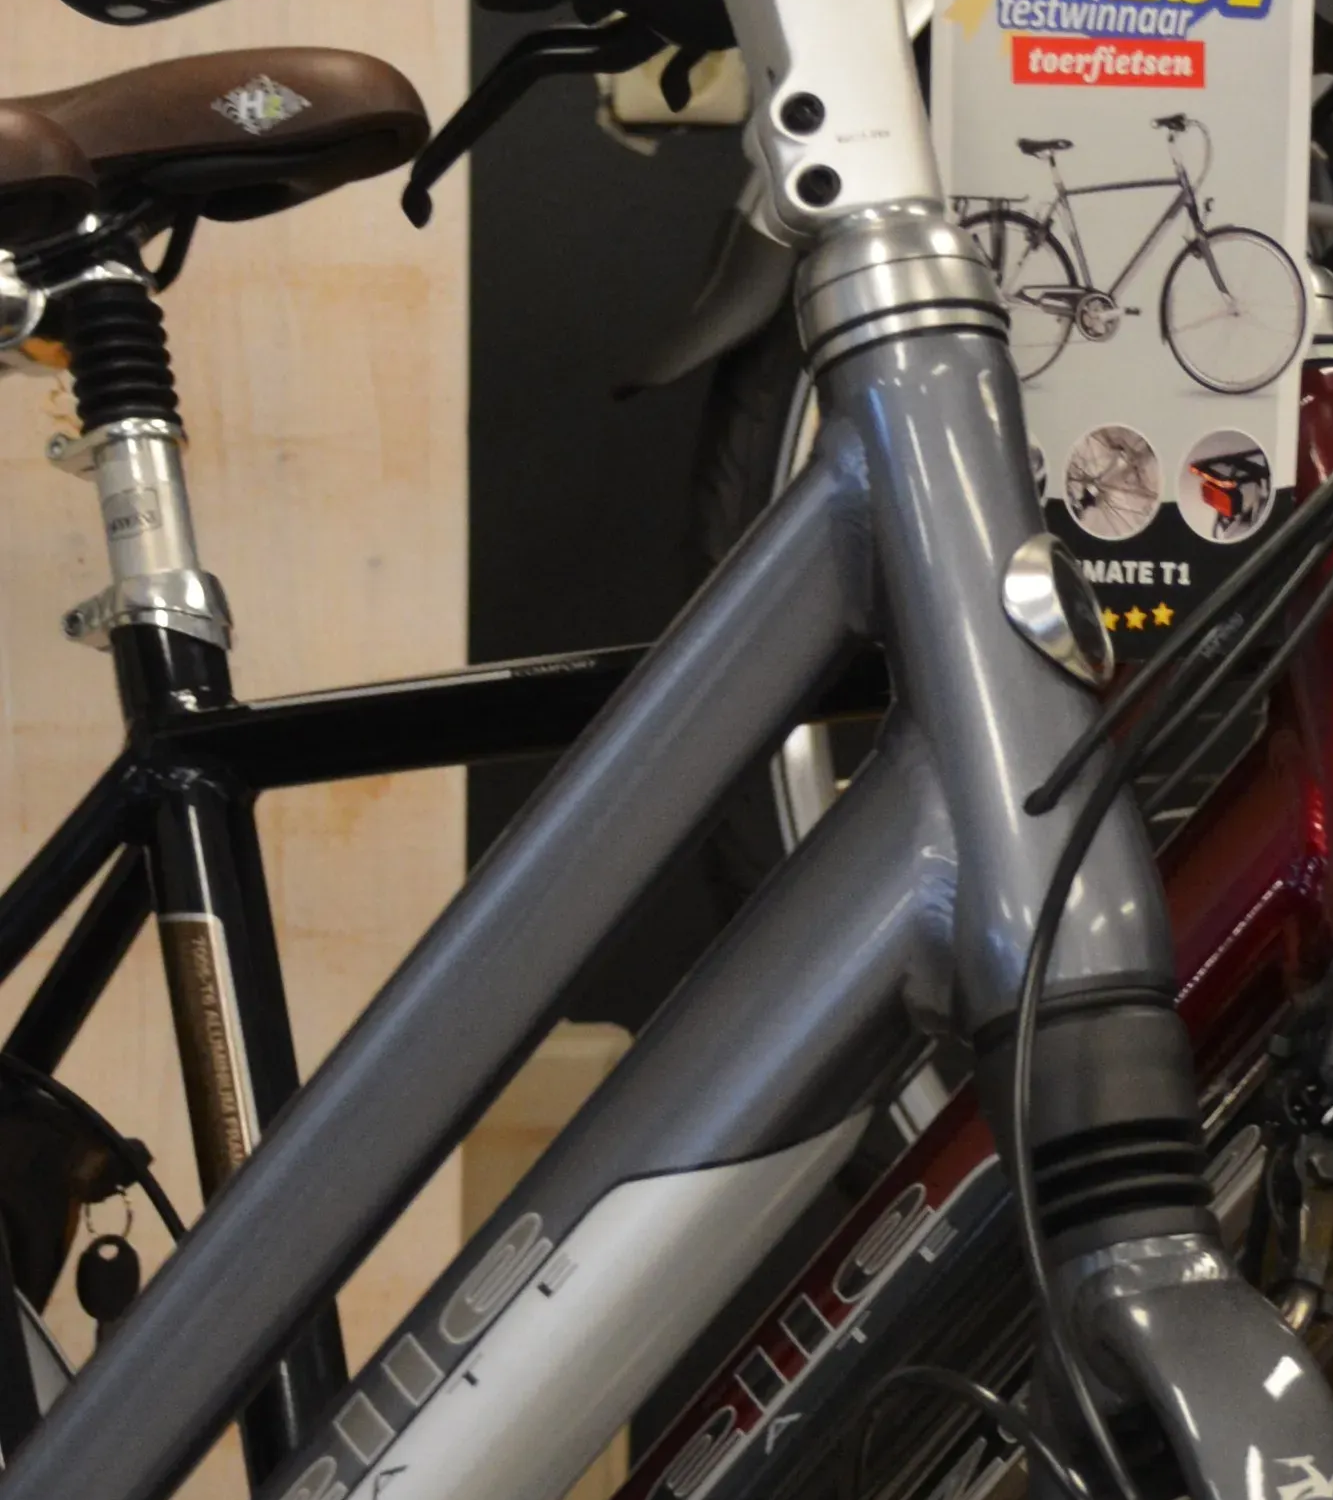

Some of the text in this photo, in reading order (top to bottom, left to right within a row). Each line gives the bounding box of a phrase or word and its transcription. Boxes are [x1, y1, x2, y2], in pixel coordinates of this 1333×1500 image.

[1028, 45, 1194, 84] toerfietsen
[1076, 559, 1192, 586] MATE T1
